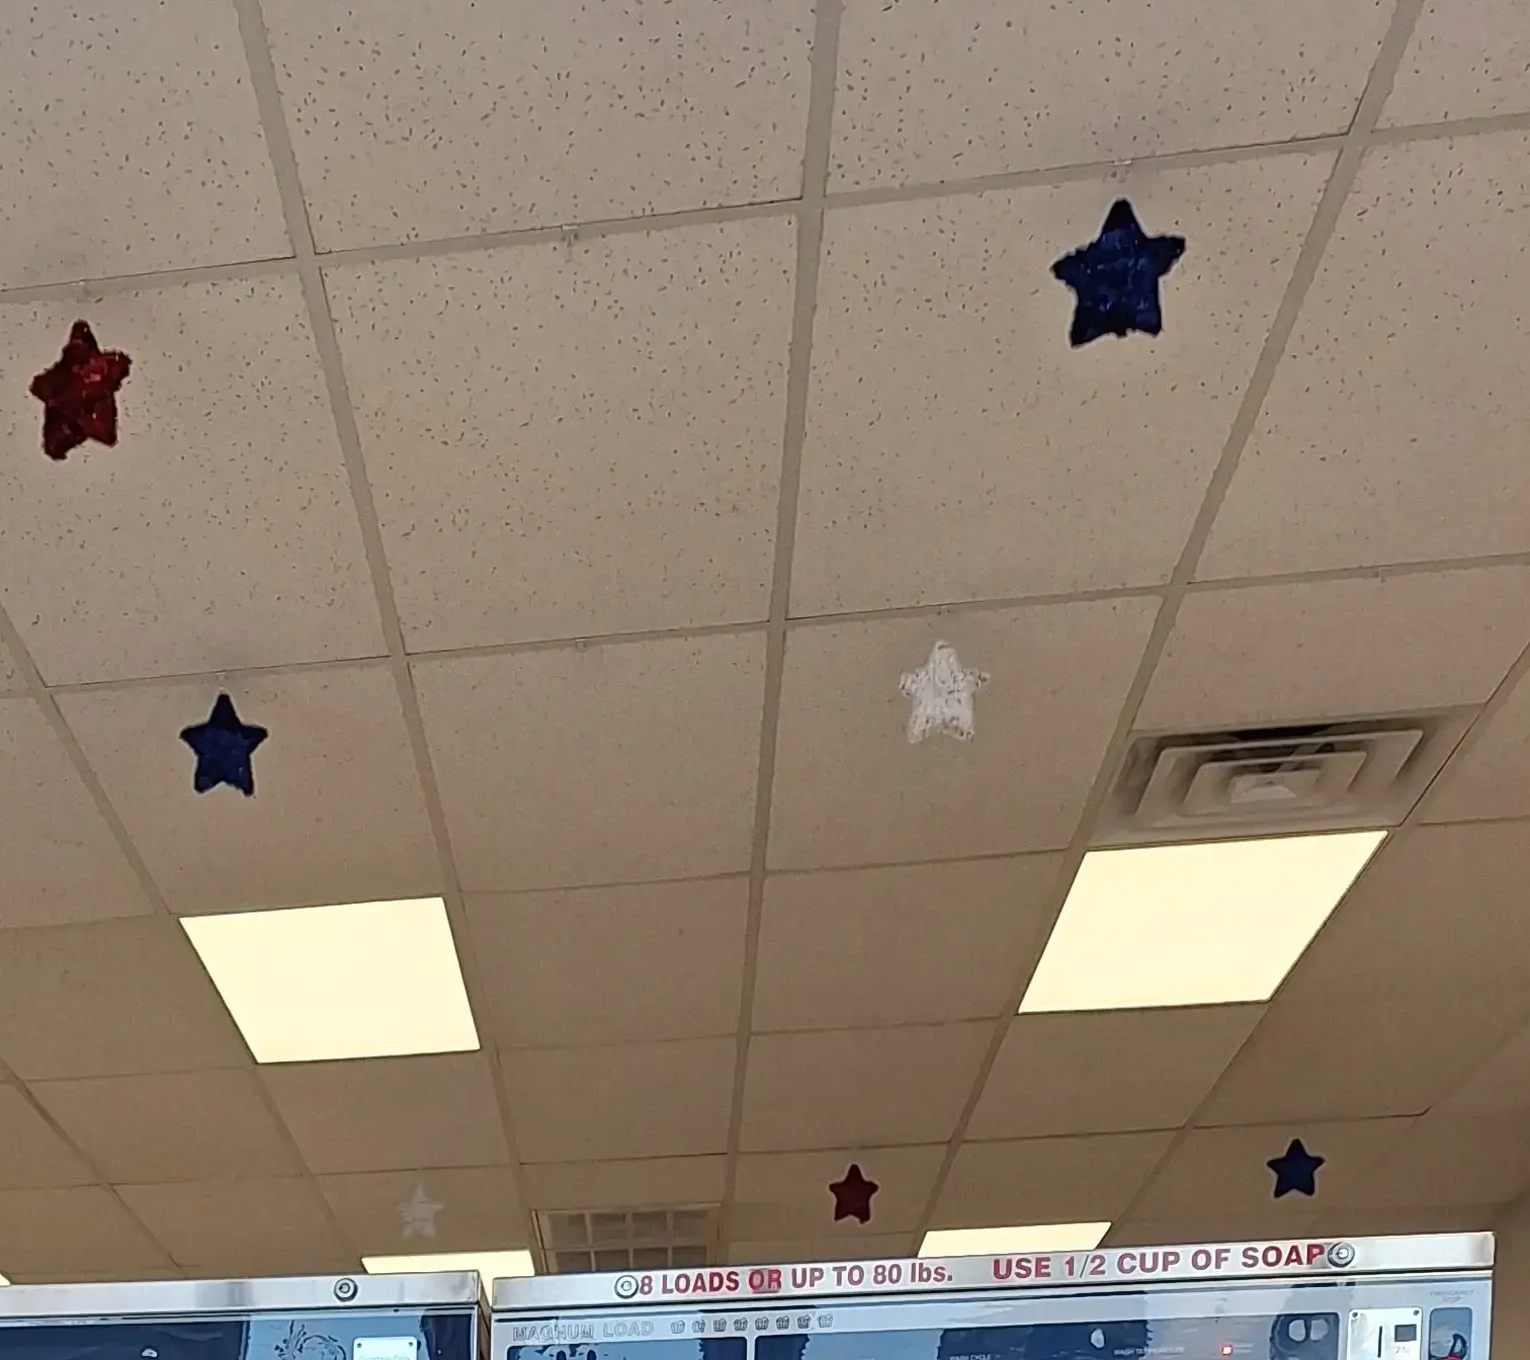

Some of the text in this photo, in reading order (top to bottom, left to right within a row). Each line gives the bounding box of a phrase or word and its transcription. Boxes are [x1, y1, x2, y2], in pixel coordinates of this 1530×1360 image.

[639, 1261, 954, 1296] 8 LOADS OR UP TO 80 lbs.
[993, 1243, 1325, 1280] USE 1/2 CUP OF SOAP
[513, 1320, 655, 1342] MAGNUM LOAD
